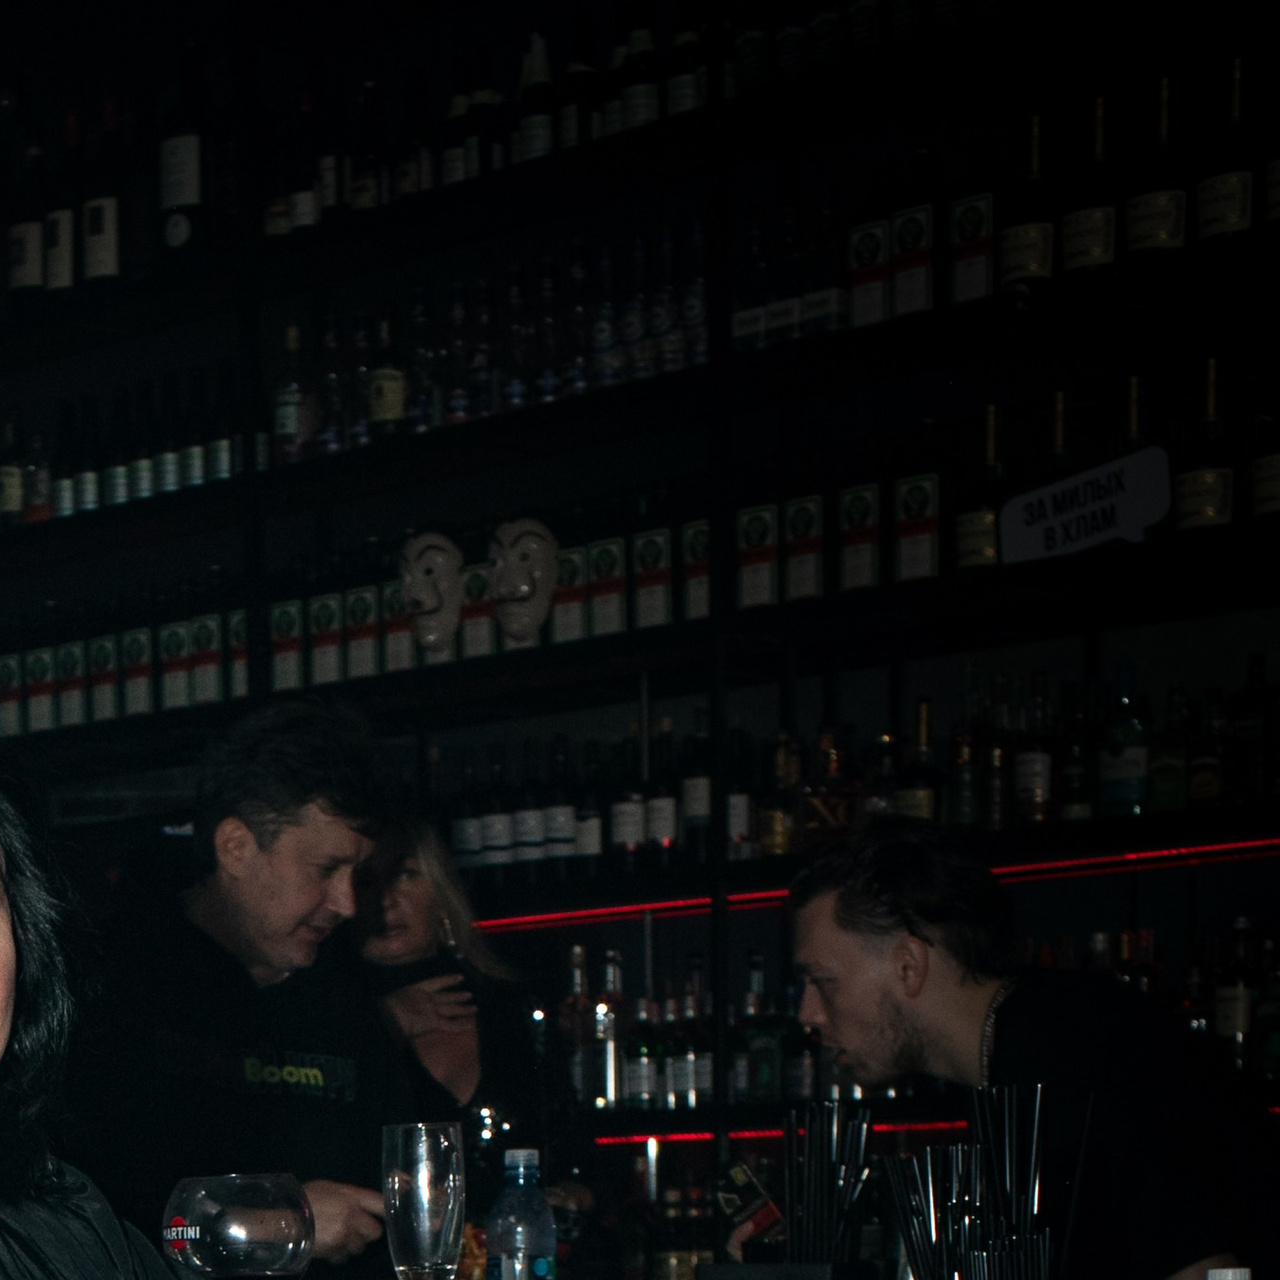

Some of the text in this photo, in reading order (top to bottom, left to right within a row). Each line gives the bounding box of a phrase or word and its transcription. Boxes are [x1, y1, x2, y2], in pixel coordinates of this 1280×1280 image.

[1023, 468, 1126, 526] ЗА МИЛЫХ
[1044, 504, 1117, 551] В ХЛАМ
[243, 1057, 324, 1087] Boom
